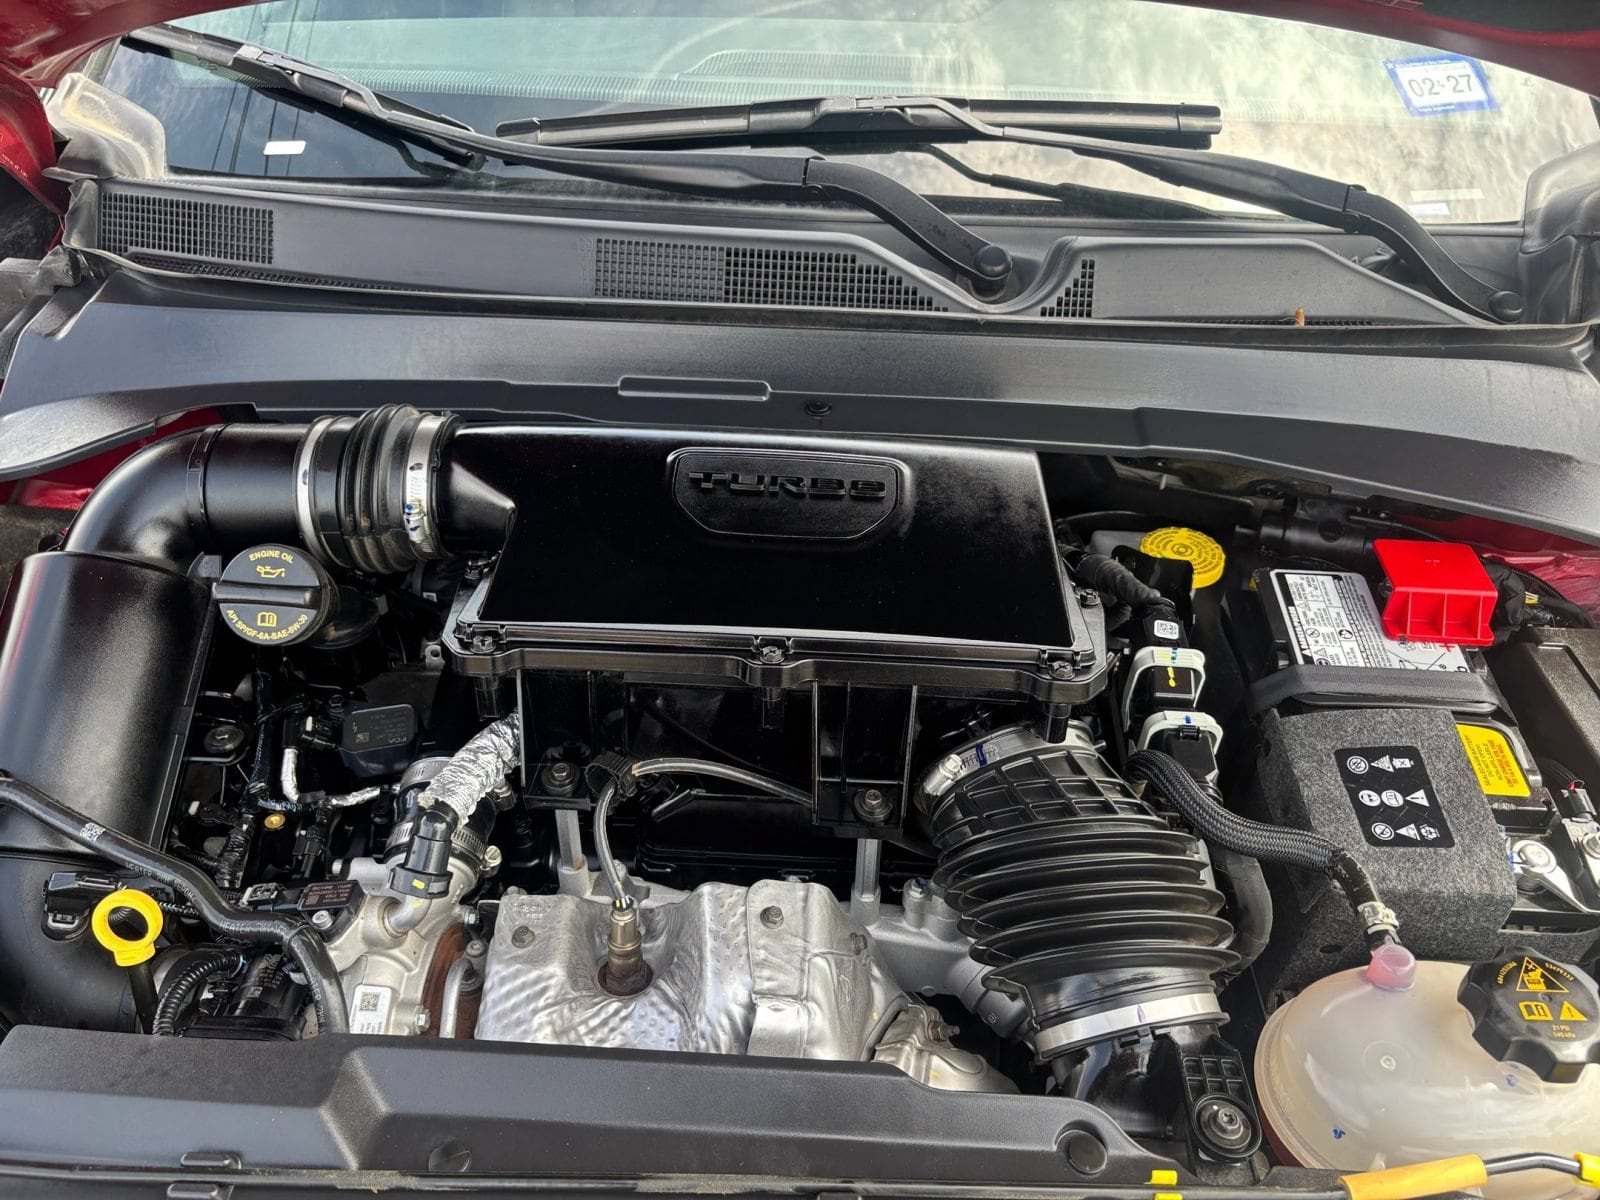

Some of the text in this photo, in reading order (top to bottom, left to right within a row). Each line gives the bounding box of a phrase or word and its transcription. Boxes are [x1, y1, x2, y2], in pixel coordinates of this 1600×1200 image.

[688, 471, 887, 498] TURBO
[248, 550, 294, 564] ENGINE OIL
[226, 609, 238, 623] API
